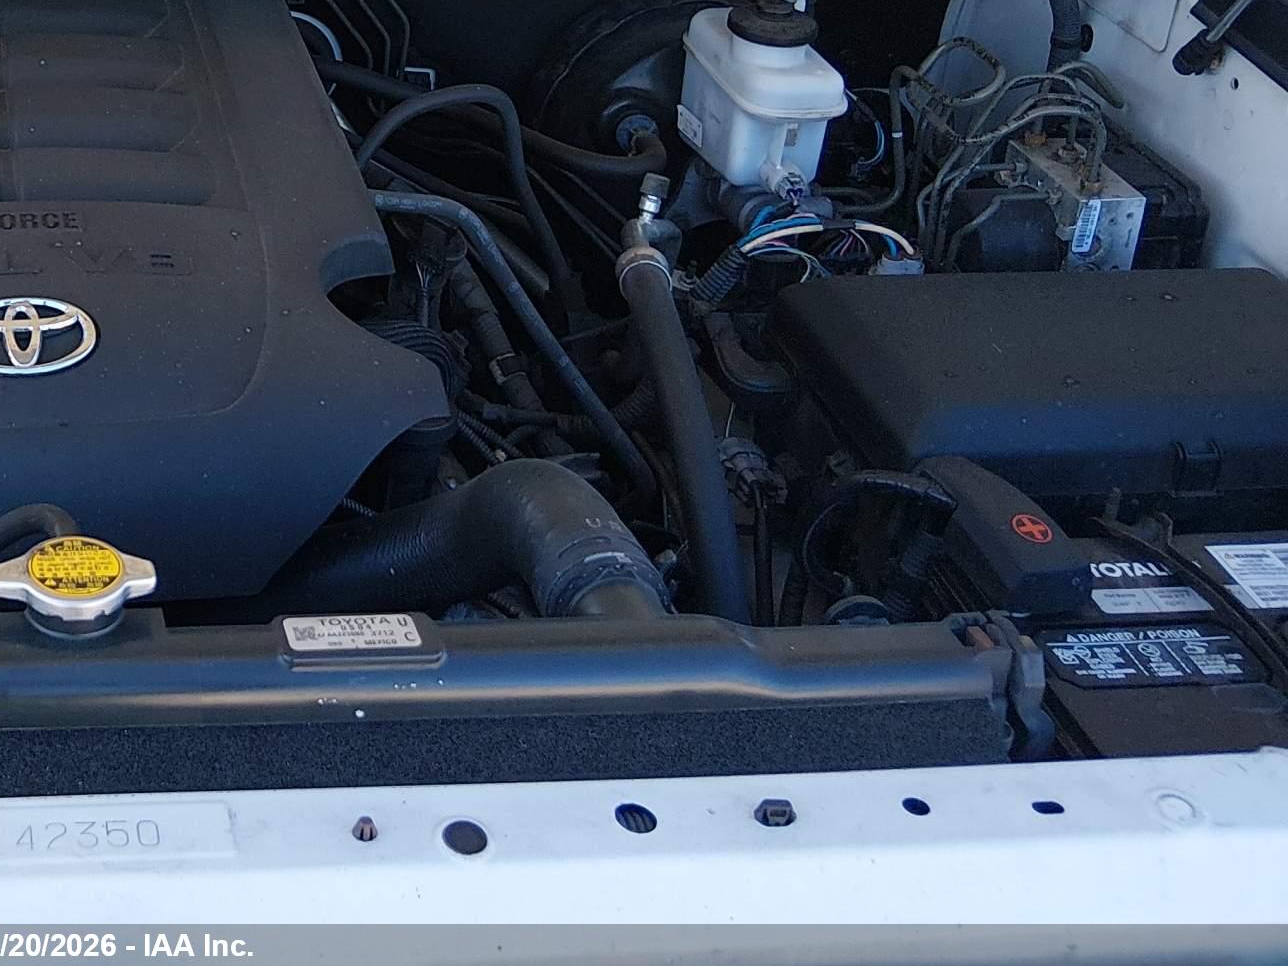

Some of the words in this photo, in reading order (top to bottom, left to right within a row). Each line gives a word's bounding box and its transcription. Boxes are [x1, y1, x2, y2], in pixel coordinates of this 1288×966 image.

[318, 617, 391, 626] TOYOTA
[1079, 632, 1137, 643] DANGER
[1147, 629, 1201, 640] POISON
[15, 819, 161, 851] 42350
